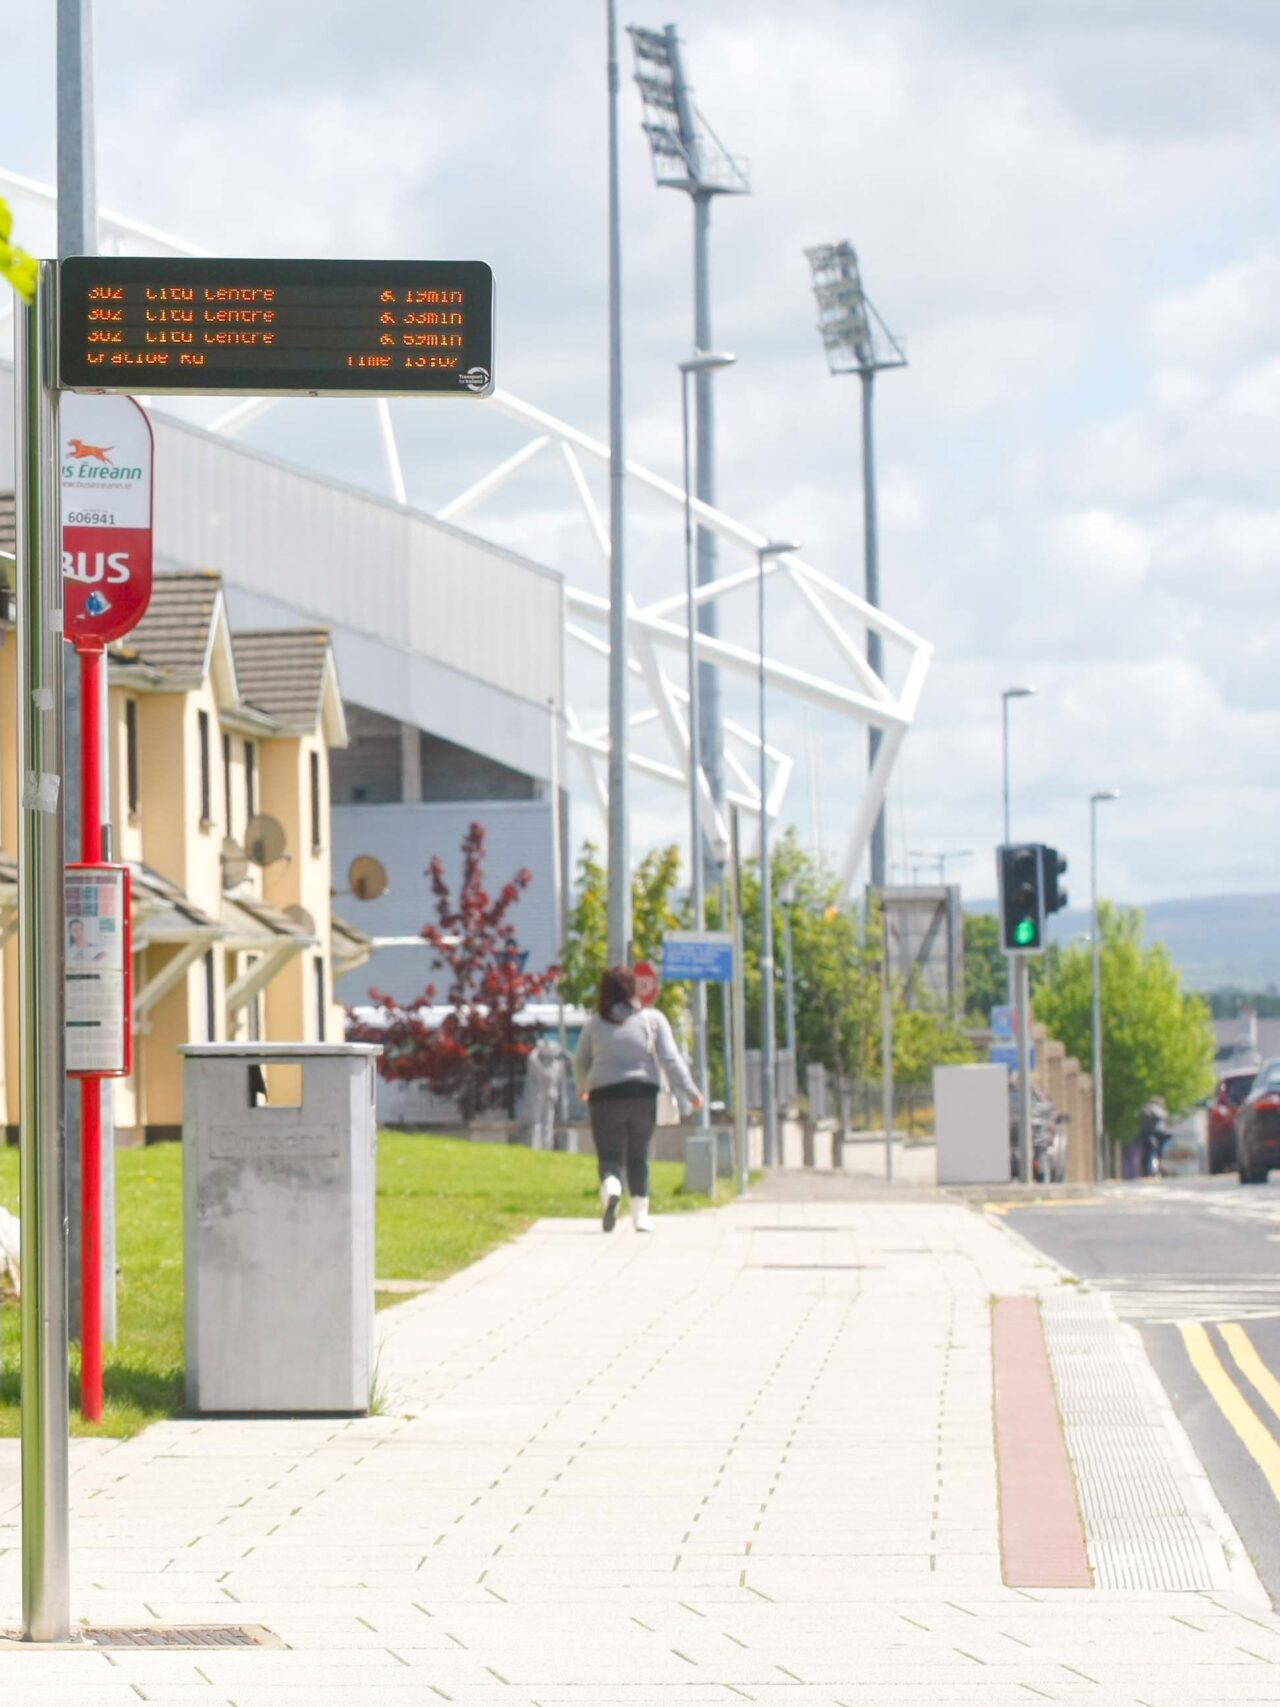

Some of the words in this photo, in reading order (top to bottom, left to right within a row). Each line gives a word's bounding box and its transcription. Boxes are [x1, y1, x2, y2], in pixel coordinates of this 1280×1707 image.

[88, 287, 123, 300] 302
[145, 287, 194, 300] City
[204, 288, 275, 300] Centre
[88, 308, 123, 322] 302
[145, 308, 194, 322] City
[204, 309, 275, 322] Centre
[88, 330, 123, 344] 302
[145, 330, 194, 344] City
[204, 331, 275, 344] Centre
[68, 512, 115, 525] 606941
